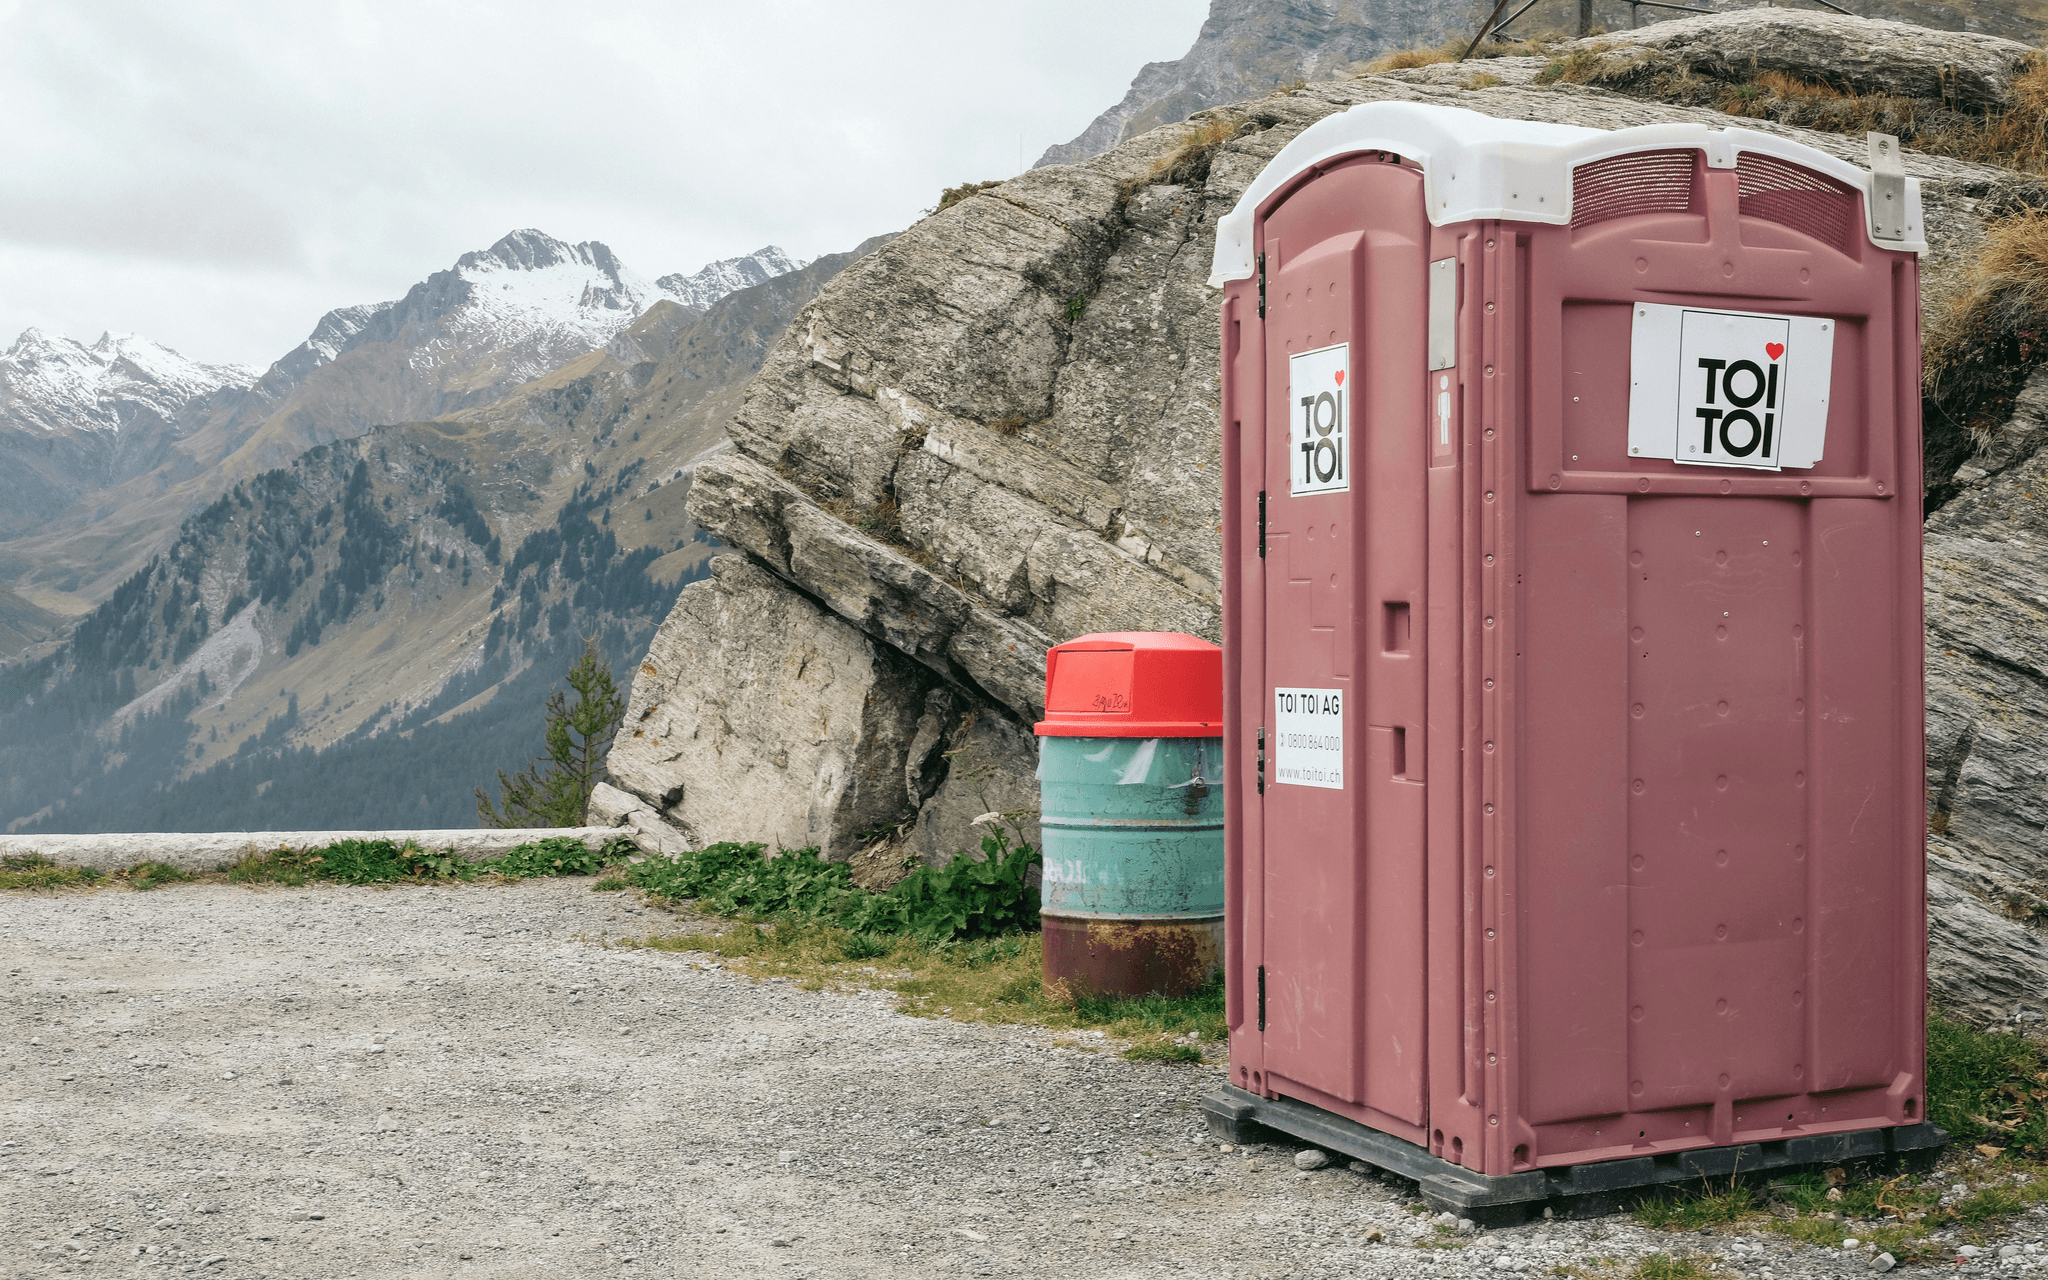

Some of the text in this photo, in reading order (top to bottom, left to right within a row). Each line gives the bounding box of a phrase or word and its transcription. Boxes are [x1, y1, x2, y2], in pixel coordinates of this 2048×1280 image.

[1698, 358, 1778, 409] TOI
[1301, 389, 1342, 438] TOI
[1696, 408, 1774, 458] TOI
[1301, 437, 1342, 484] TOI
[1278, 693, 1340, 715] TOI TOI AG
[1288, 733, 1340, 751] 0800 864 000
[1278, 767, 1341, 783] www.toitoi.ch
